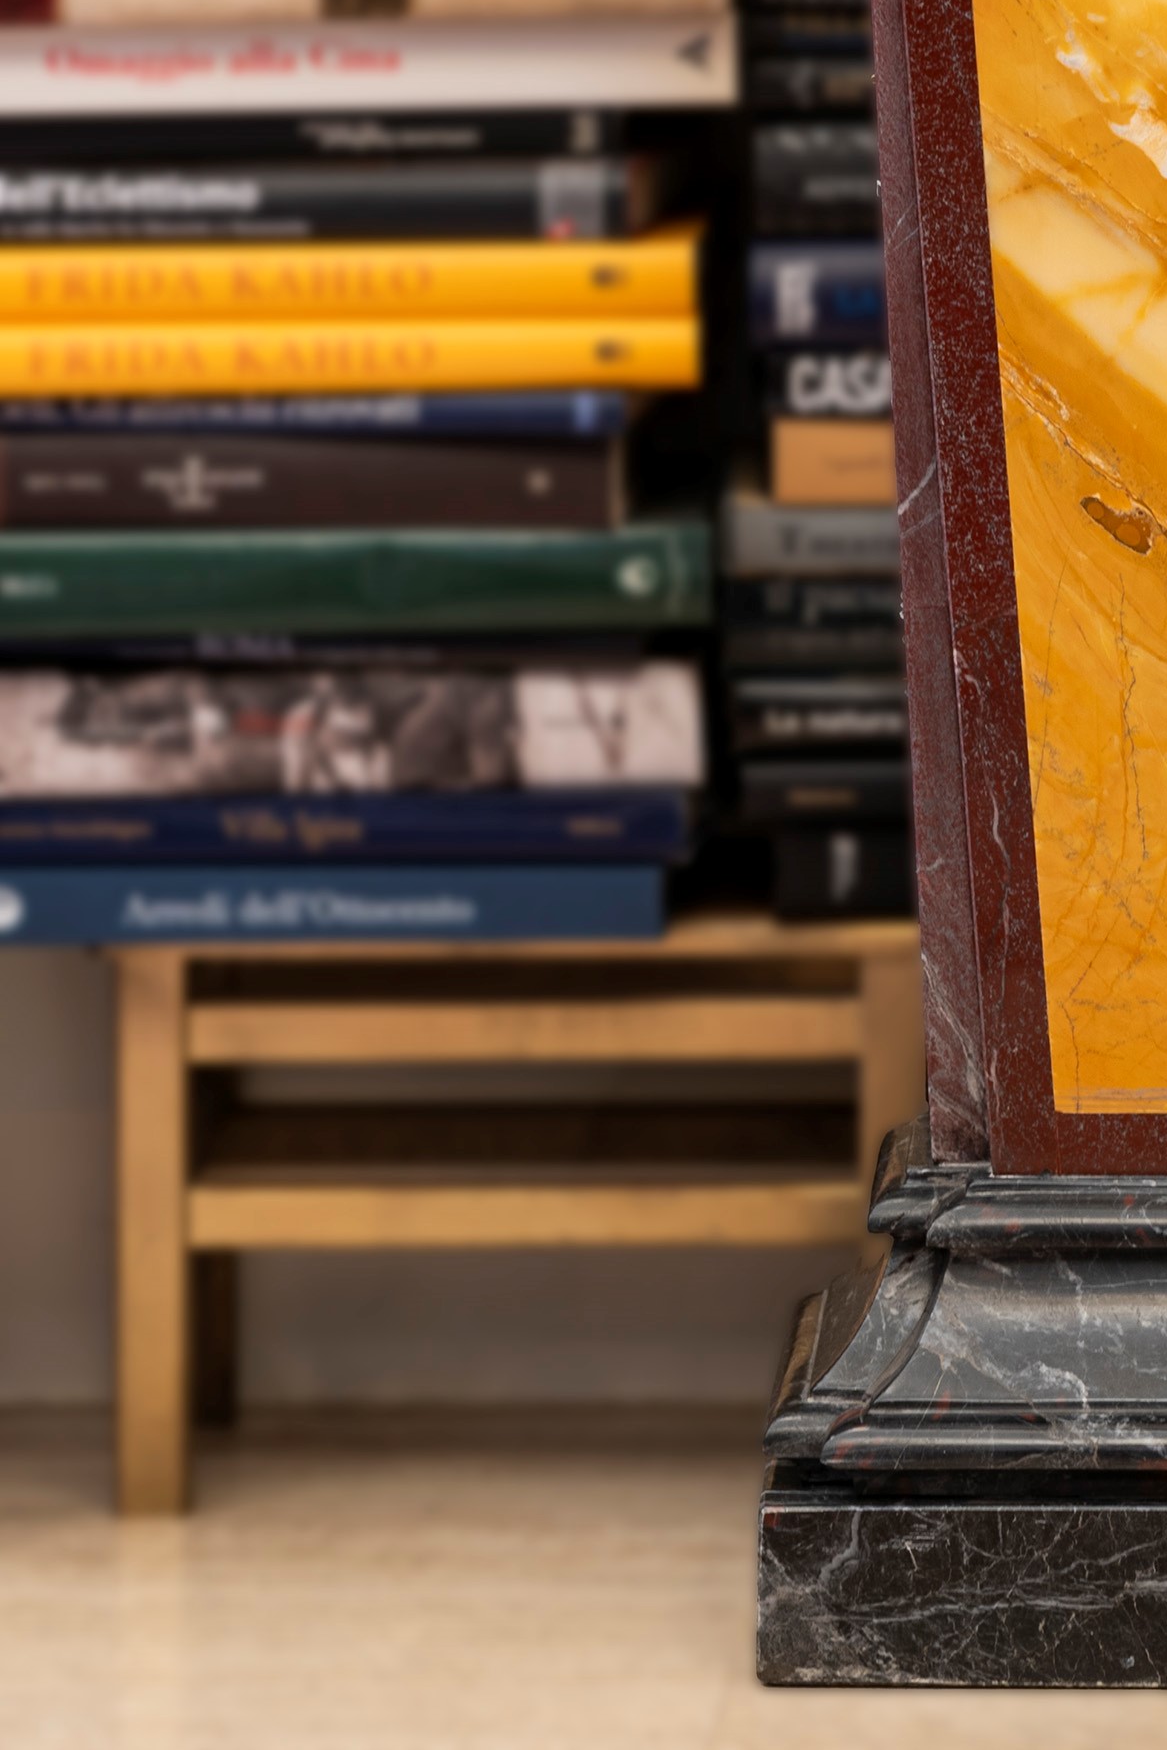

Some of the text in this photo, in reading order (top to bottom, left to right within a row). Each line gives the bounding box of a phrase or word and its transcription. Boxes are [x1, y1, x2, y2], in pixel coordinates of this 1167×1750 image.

[25, 261, 435, 304] FRIDA KAHLO
[27, 337, 437, 379] FRIDA KAHLO
[120, 891, 476, 927] Arredi dell'Ottocento
